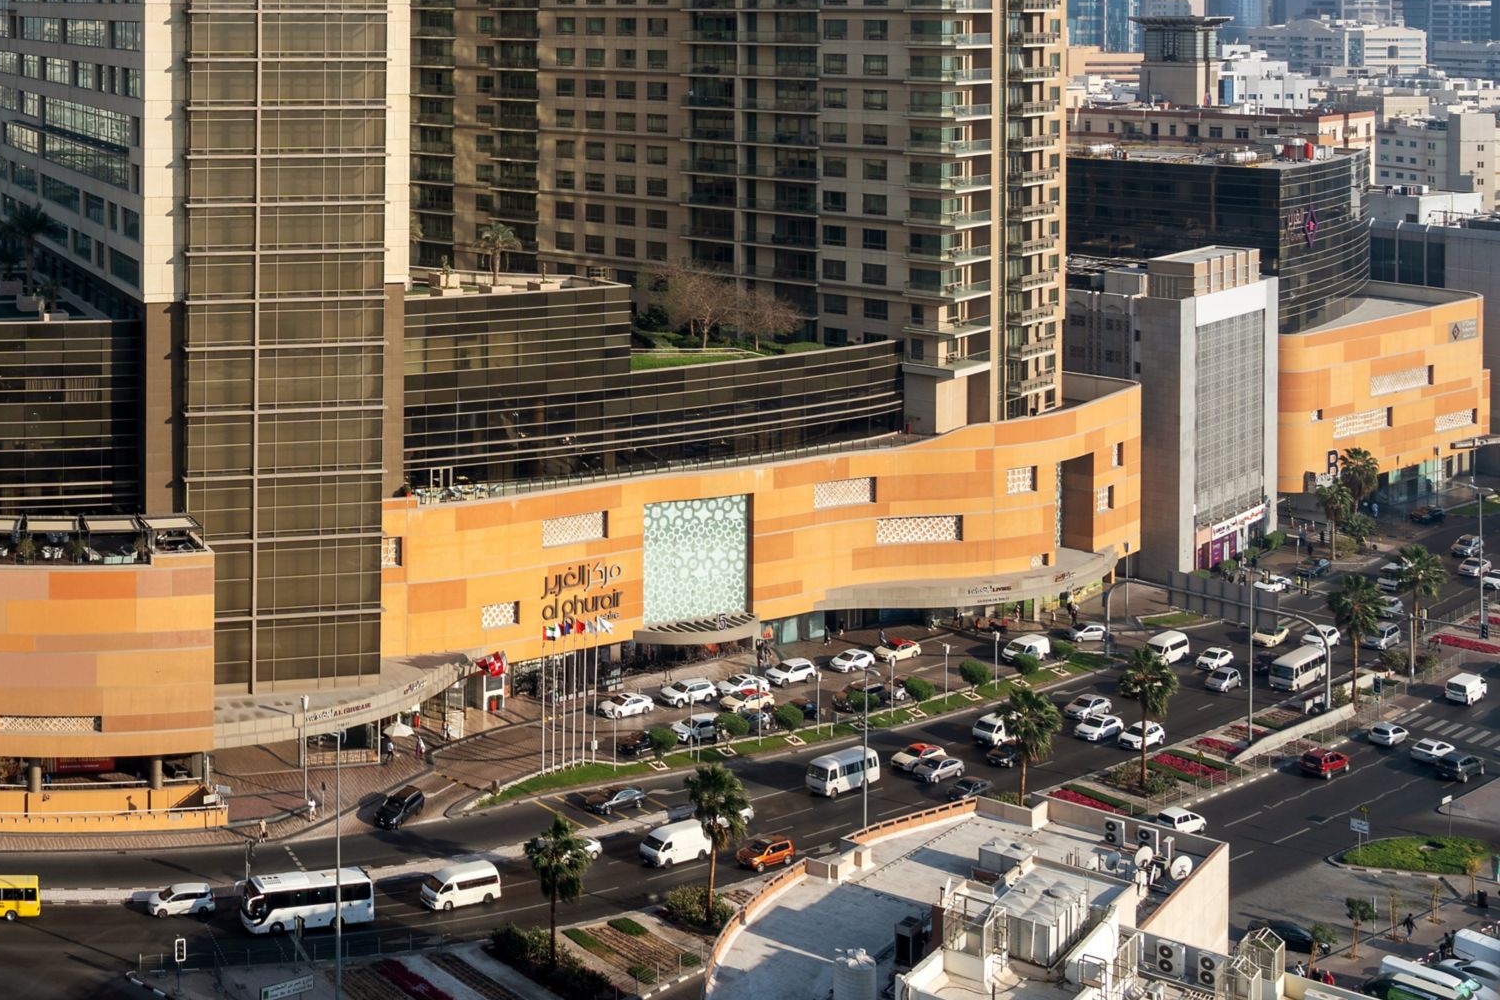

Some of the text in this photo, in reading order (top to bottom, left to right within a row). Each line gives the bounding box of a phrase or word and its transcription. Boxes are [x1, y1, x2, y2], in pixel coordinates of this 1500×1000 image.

[540, 562, 621, 600] مركز الغرير
[542, 589, 623, 625] al ghurair
